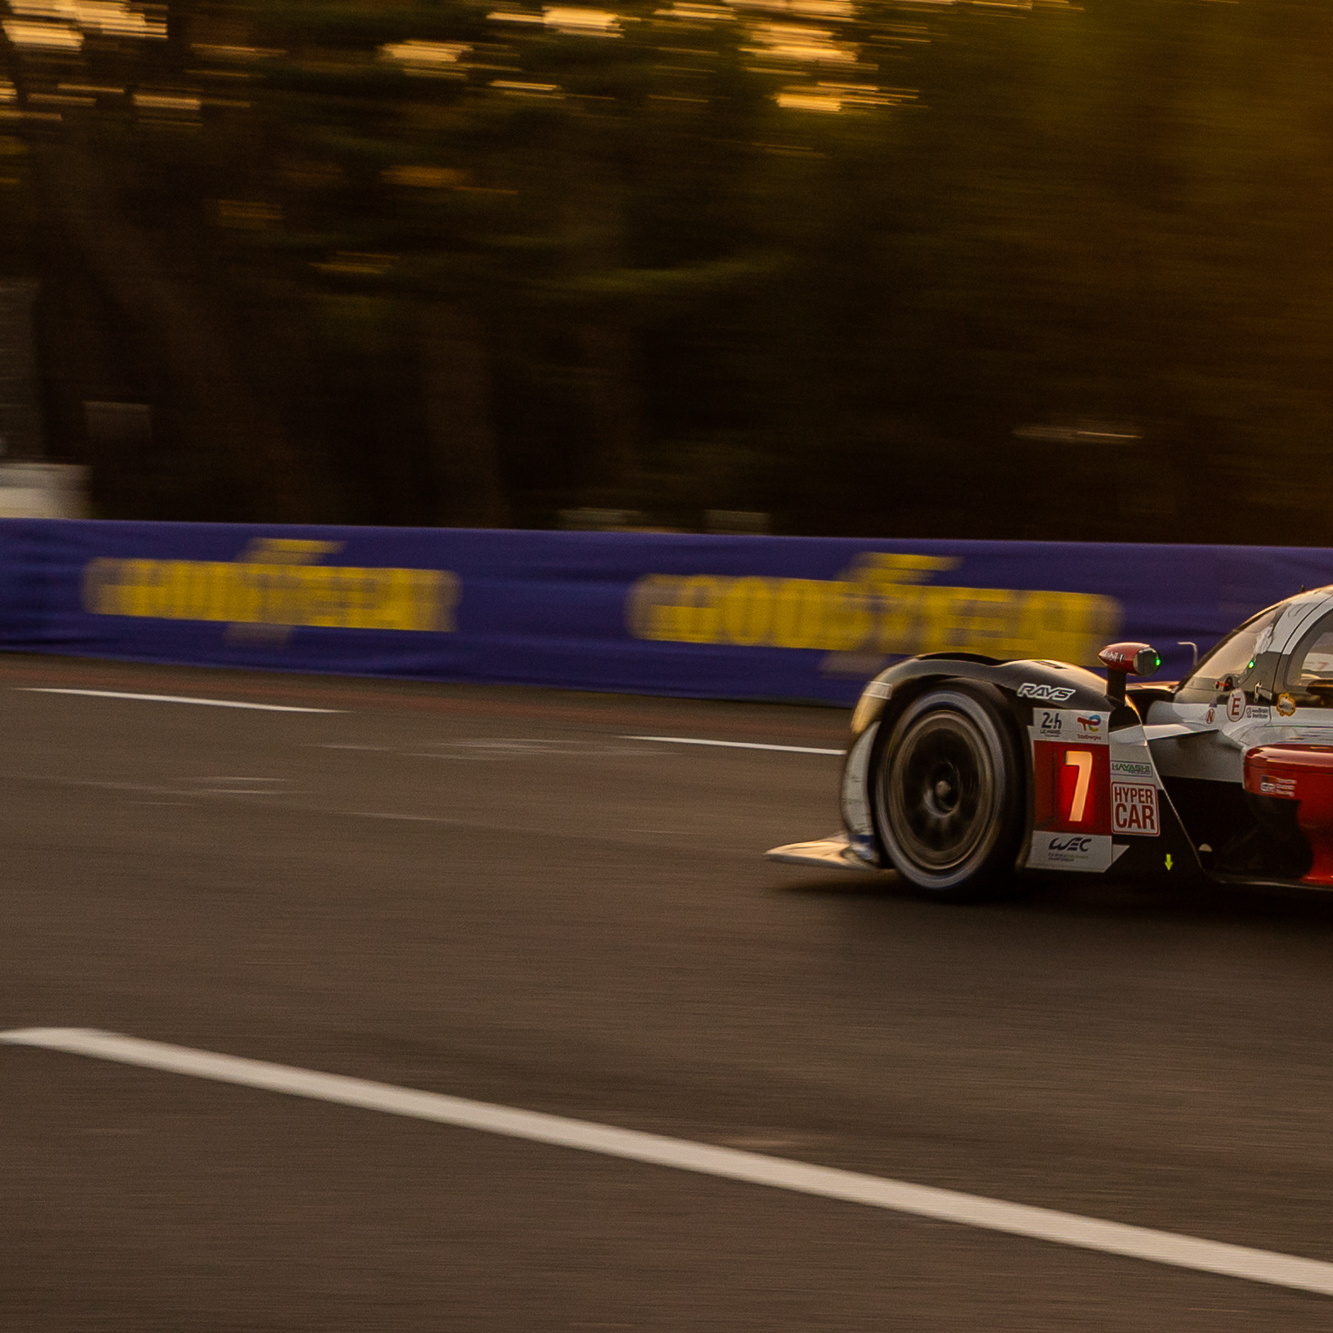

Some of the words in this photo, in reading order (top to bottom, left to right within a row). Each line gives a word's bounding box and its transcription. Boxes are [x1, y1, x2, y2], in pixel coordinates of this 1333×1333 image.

[1017, 683, 1076, 701] RAYS
[1231, 697, 1241, 716] E
[1041, 712, 1062, 729] 24h
[1064, 750, 1093, 822] 7
[1114, 786, 1153, 804] HYPER
[1115, 803, 1155, 830] CAR
[1048, 837, 1092, 852] WEC
